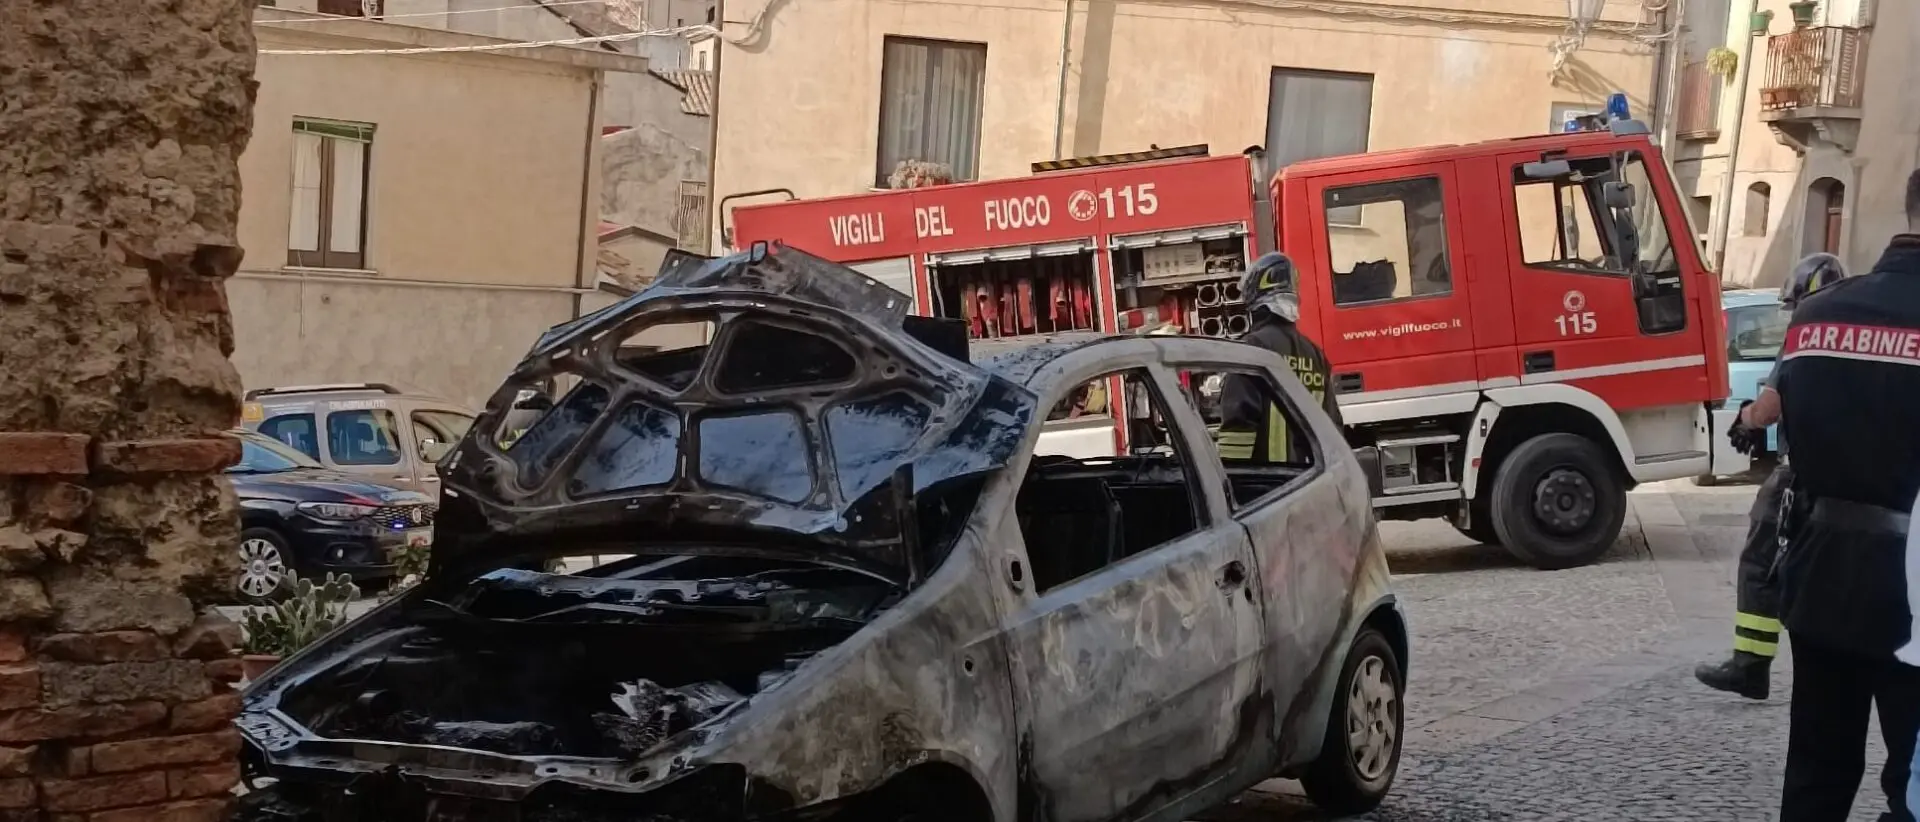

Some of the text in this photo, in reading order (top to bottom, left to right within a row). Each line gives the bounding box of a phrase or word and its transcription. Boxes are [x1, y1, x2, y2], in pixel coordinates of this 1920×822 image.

[829, 183, 1158, 246] VIGILI DEL FUOCO 115
[1343, 318, 1461, 340] www.vigilfuoco.it
[1554, 312, 1597, 336] 115
[1798, 326, 1920, 358] CARABINIE
